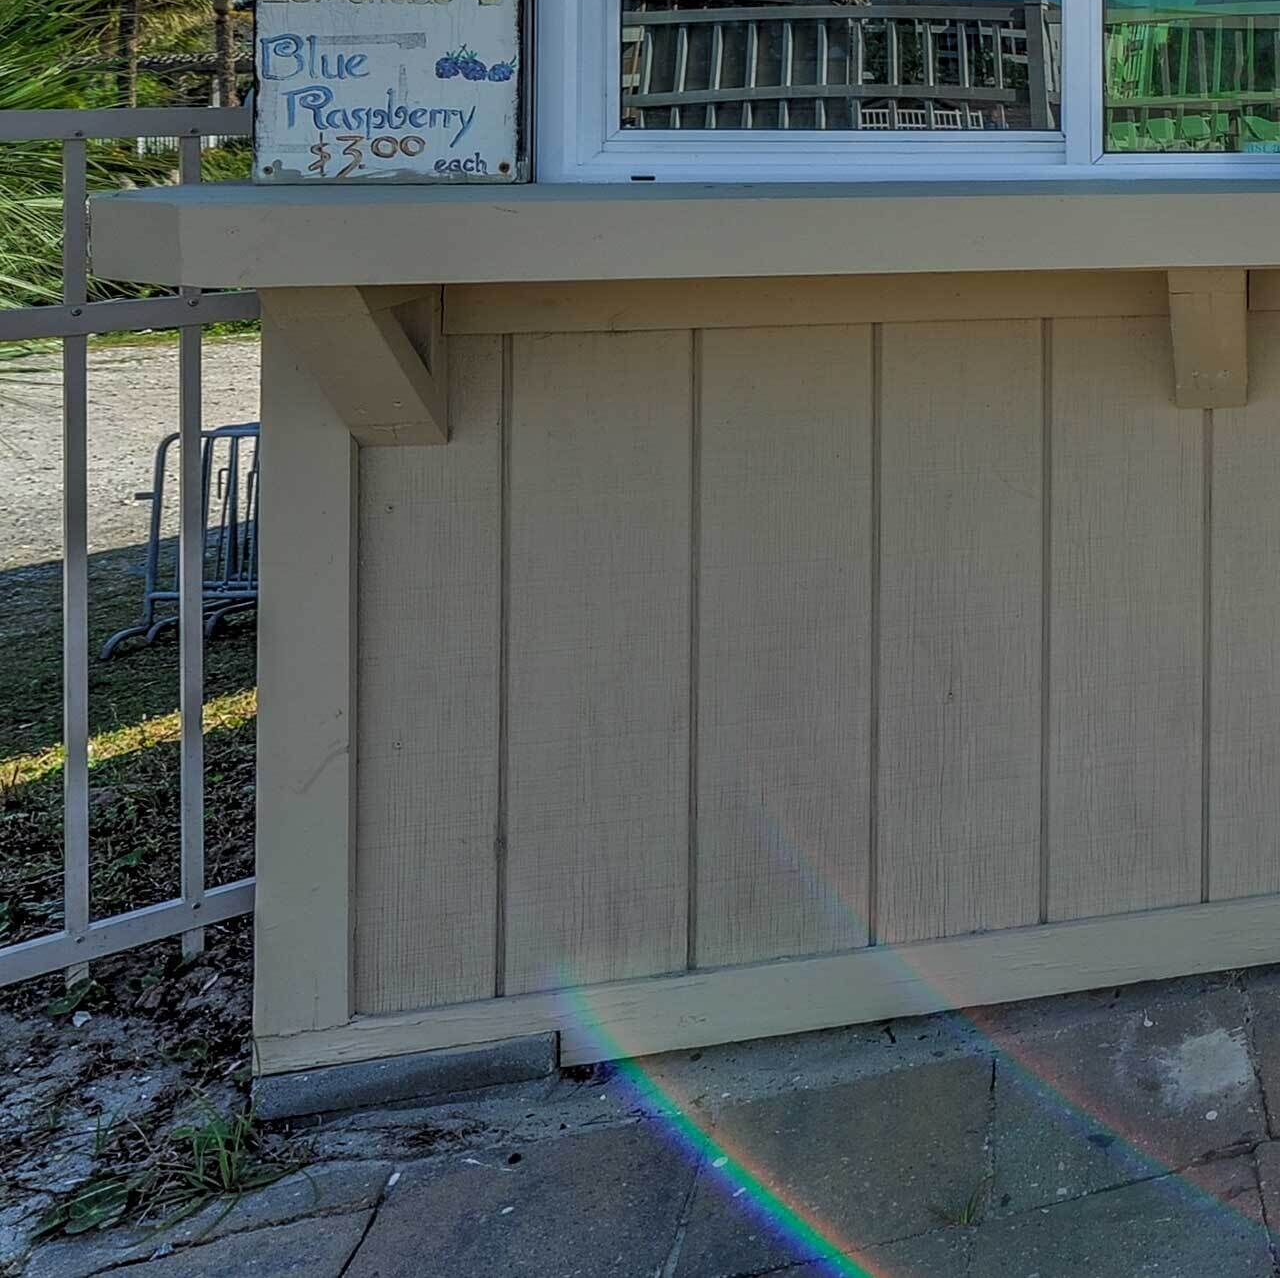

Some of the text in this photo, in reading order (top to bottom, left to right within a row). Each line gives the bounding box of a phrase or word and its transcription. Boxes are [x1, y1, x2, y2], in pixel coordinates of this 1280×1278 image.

[260, 34, 370, 81] Blue
[282, 85, 477, 149] Raspberry
[435, 153, 489, 175] each
